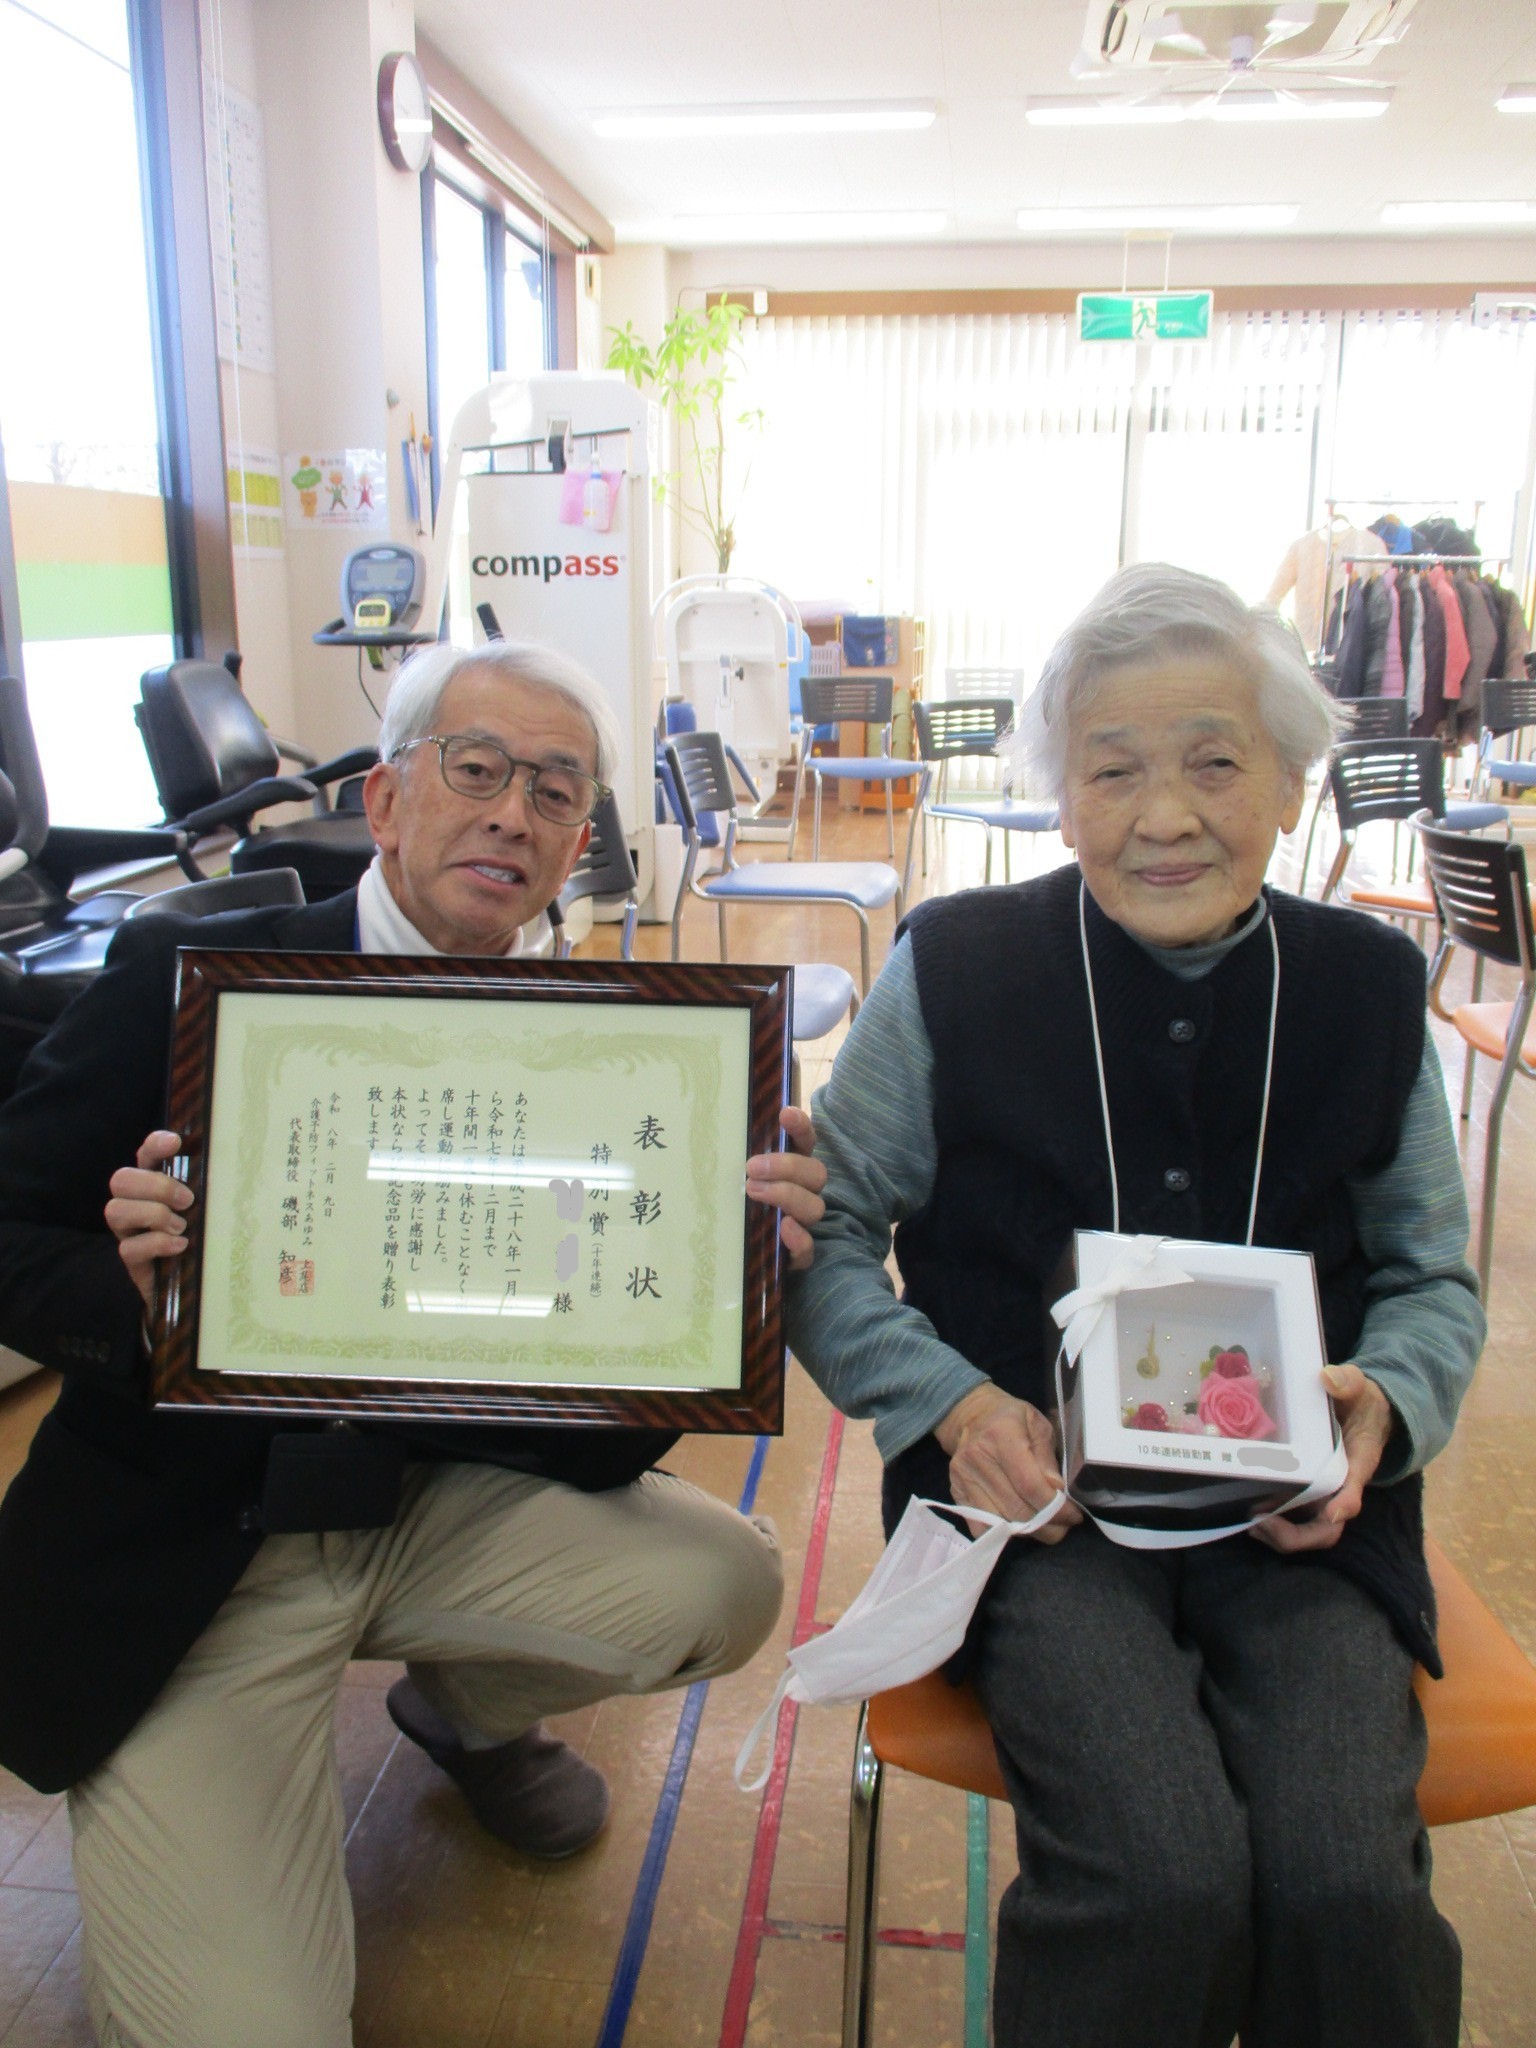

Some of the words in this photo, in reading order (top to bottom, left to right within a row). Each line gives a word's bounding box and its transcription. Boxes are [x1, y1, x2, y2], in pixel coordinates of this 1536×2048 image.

[472, 555, 619, 582] compass
[381, 1086, 408, 1309] 本状なら念品を贈り表彰
[407, 1088, 431, 1272] よってそ労に感謝し
[434, 1088, 455, 1264] 席し運動みました。
[456, 1089, 481, 1310] 十年間一休むことなく
[504, 1091, 528, 1310] あなたは二十八年一月
[626, 1115, 668, 1298] 表彰状
[552, 1292, 573, 1313] 様
